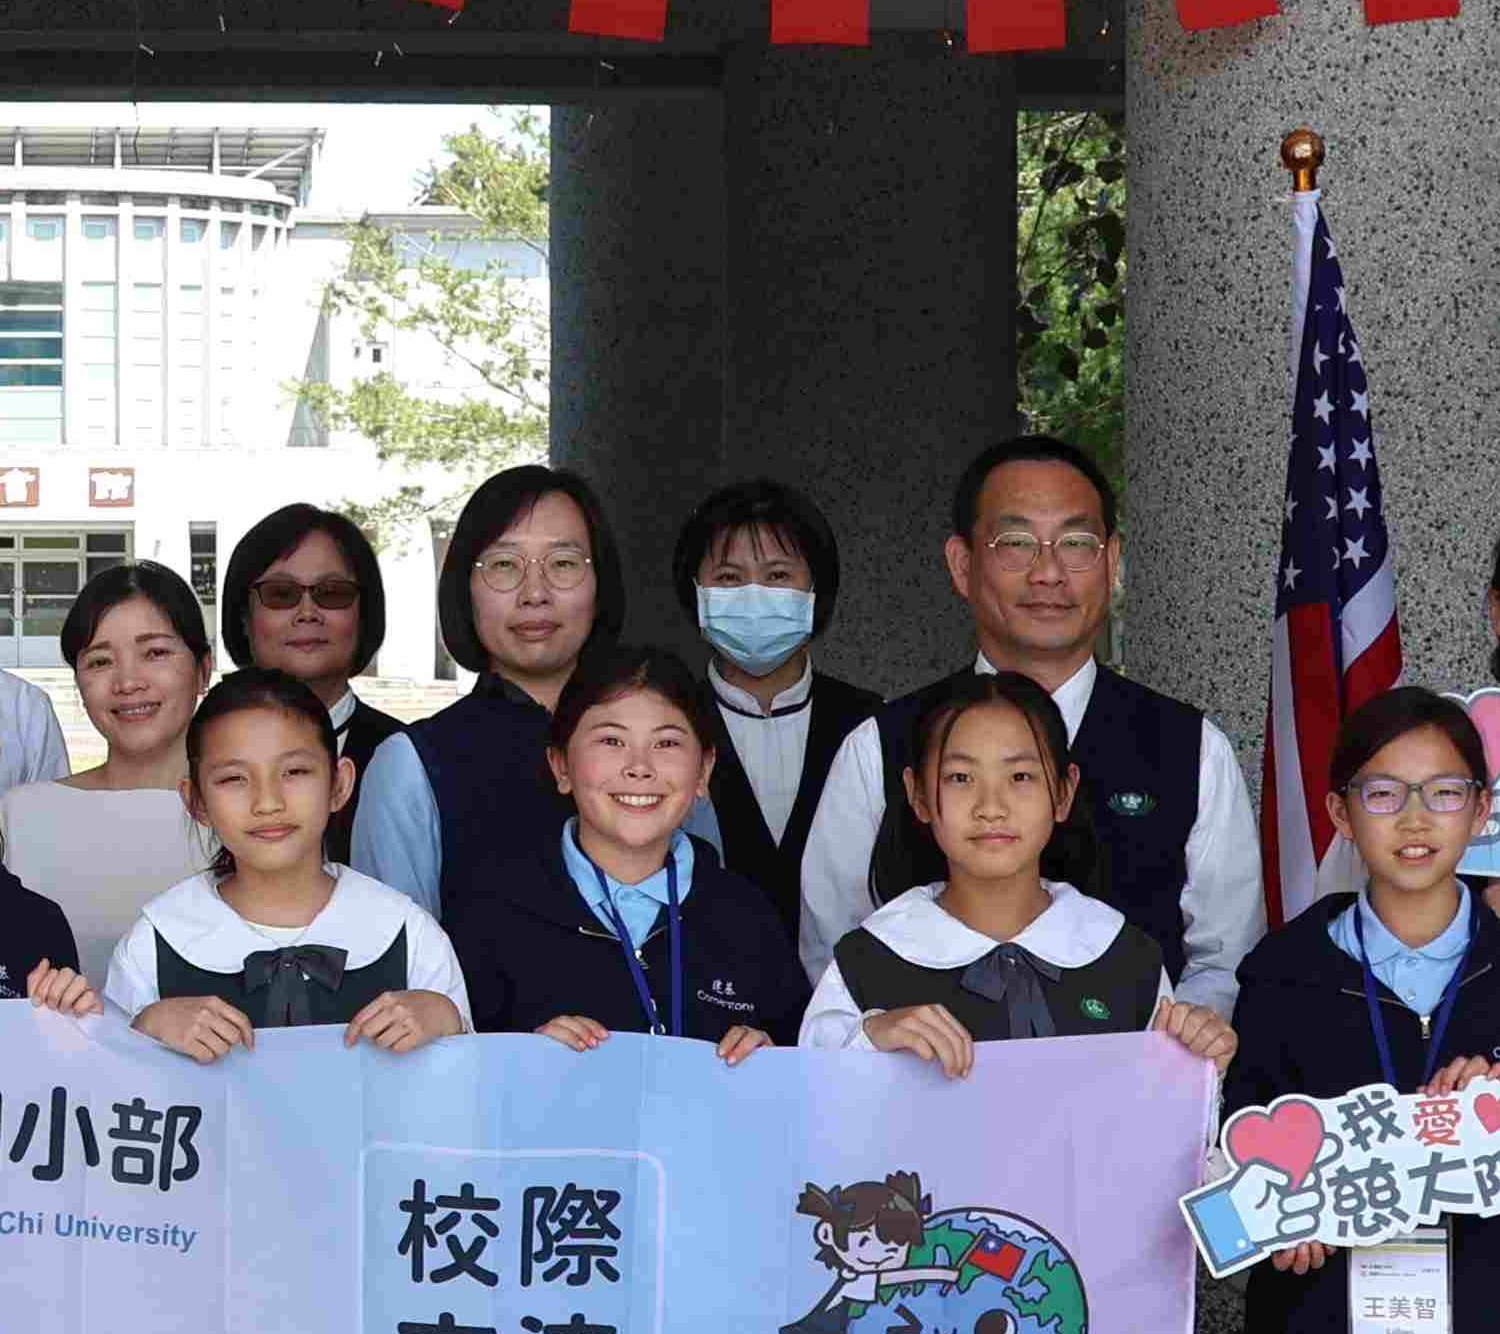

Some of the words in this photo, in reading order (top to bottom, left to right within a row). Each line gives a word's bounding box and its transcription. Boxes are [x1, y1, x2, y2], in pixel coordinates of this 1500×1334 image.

[1336, 1089, 1462, 1152] 我愛
[54, 1212, 199, 1253] University
[397, 1178, 622, 1287] 校際
[1363, 1295, 1437, 1320] 王美智
